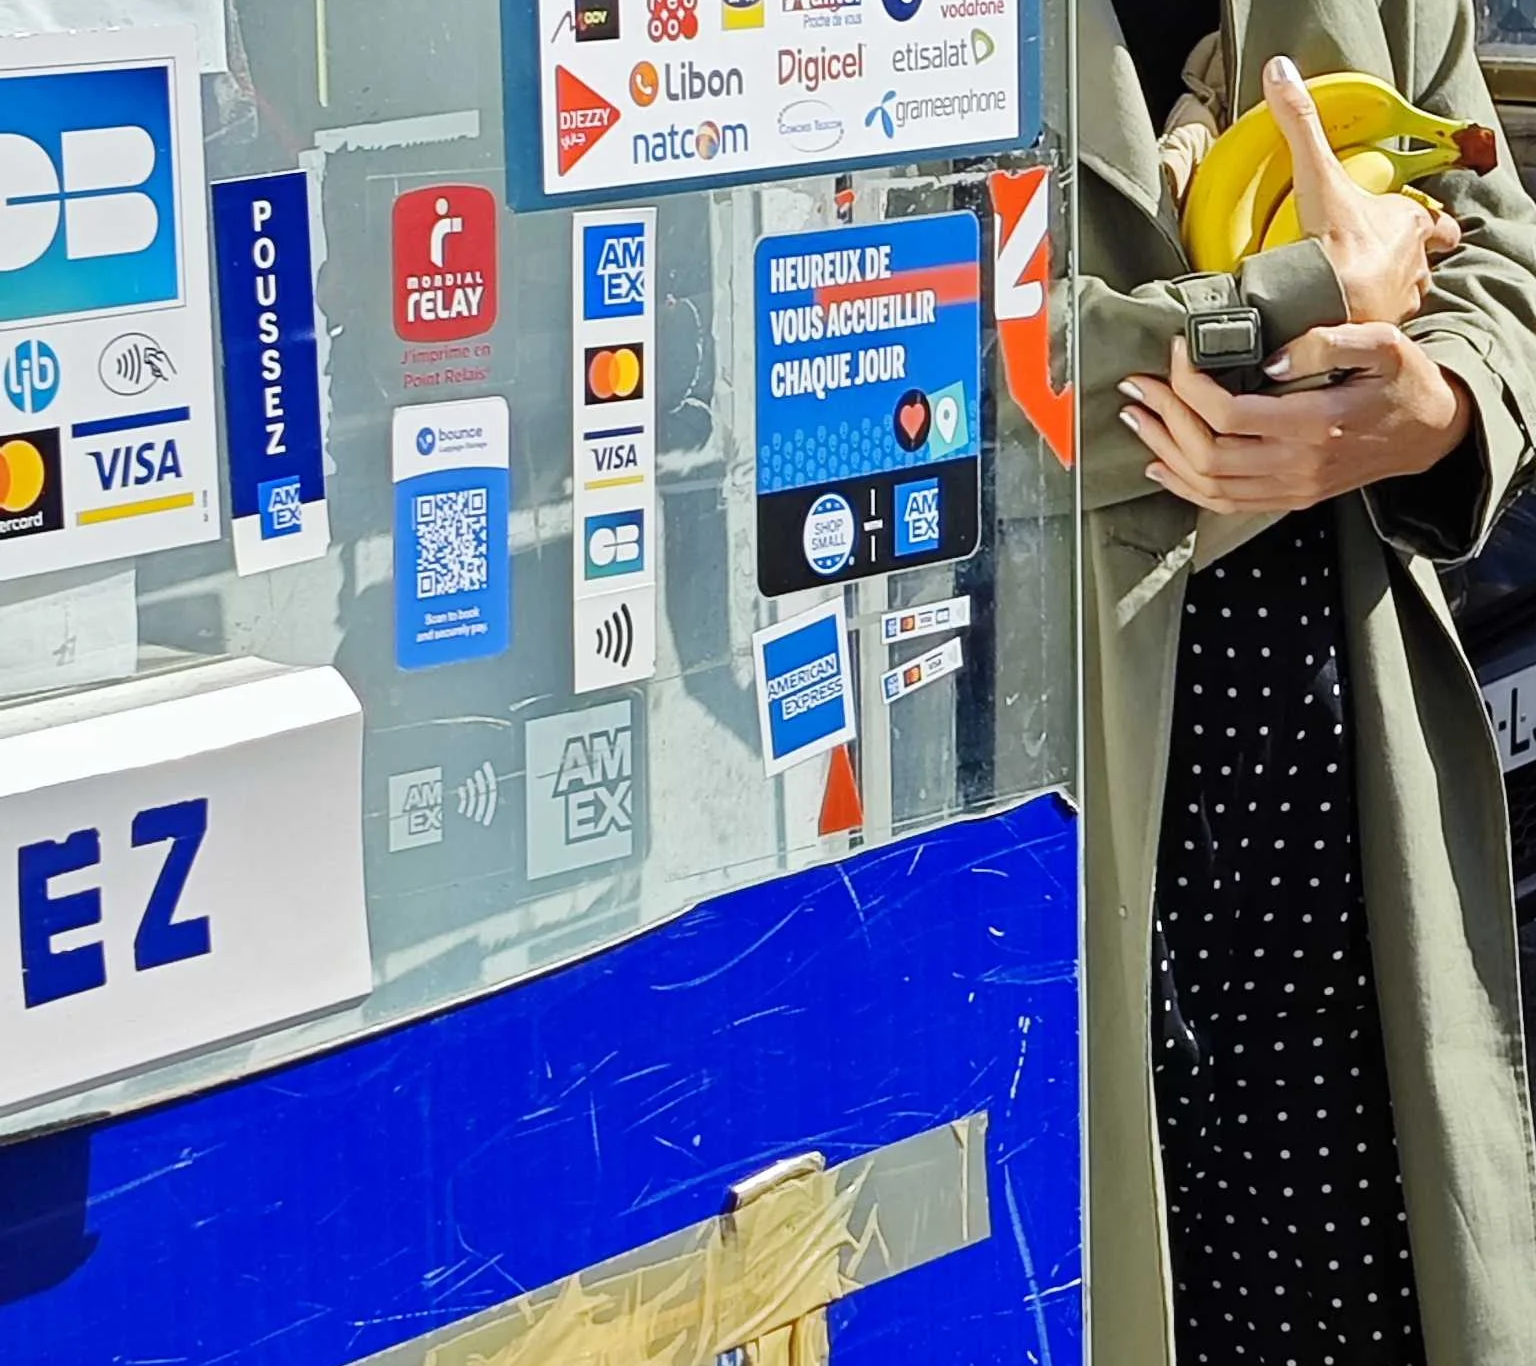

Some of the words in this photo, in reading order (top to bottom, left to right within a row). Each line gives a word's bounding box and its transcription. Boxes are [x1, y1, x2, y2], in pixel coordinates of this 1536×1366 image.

[778, 42, 863, 93] Digicel
[892, 39, 968, 72] etisalat
[665, 61, 743, 101] Libon
[560, 109, 611, 130] DJEZZY
[896, 89, 1006, 128] grameenphone
[406, 270, 483, 290] MONDIAL
[770, 250, 863, 294] HEUREUX
[865, 245, 892, 280] DE
[251, 198, 287, 456] POUSSEZ
[770, 304, 825, 346] VOUS
[826, 290, 936, 340] ACCUEILLIR
[401, 345, 471, 366] J'imprime
[474, 343, 491, 358] en
[770, 352, 852, 401] CHAQUE
[854, 344, 906, 386] JOUR
[403, 372, 441, 390] Point
[438, 428, 483, 442] bounce
[85, 437, 184, 493] VISA
[591, 443, 639, 472] VISA
[811, 533, 847, 552] SMALL
[813, 517, 845, 536] SHOP
[768, 653, 838, 700] AMERICAN
[782, 678, 844, 721] EXPRESS
[18, 797, 212, 1009] EZ
